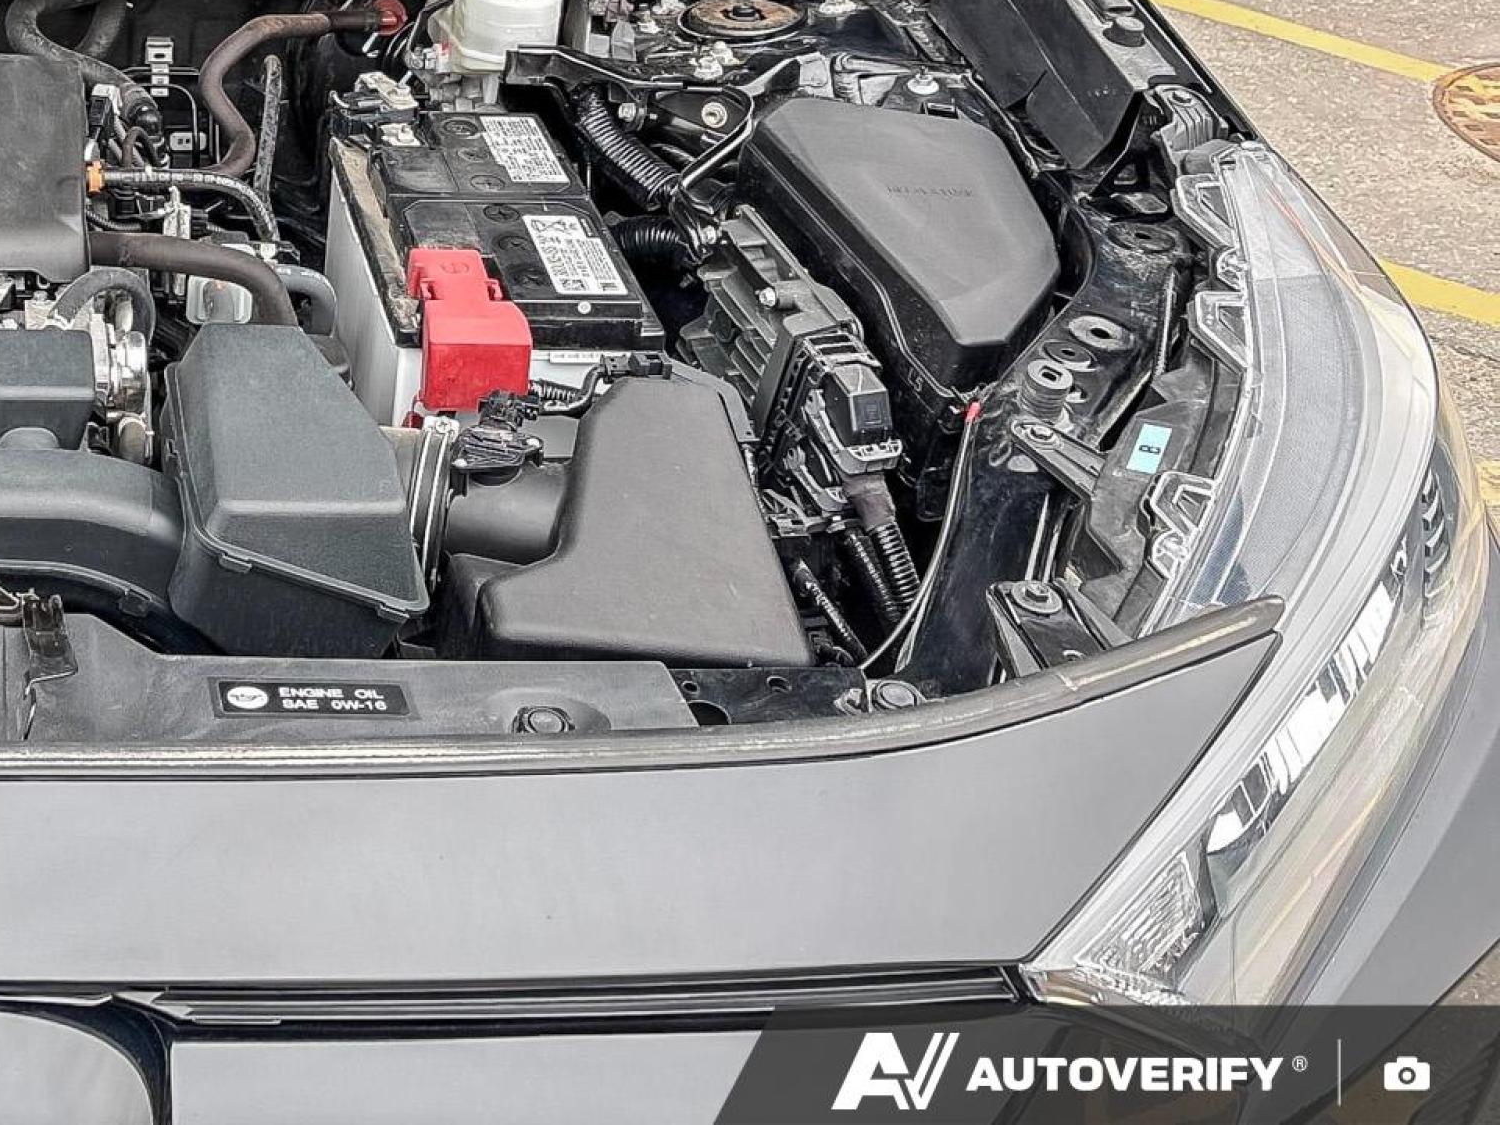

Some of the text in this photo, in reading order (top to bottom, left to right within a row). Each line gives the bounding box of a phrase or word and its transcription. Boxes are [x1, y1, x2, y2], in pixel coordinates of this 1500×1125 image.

[277, 686, 385, 699] ENGINE OIL
[281, 698, 388, 711] SAE 0W-16
